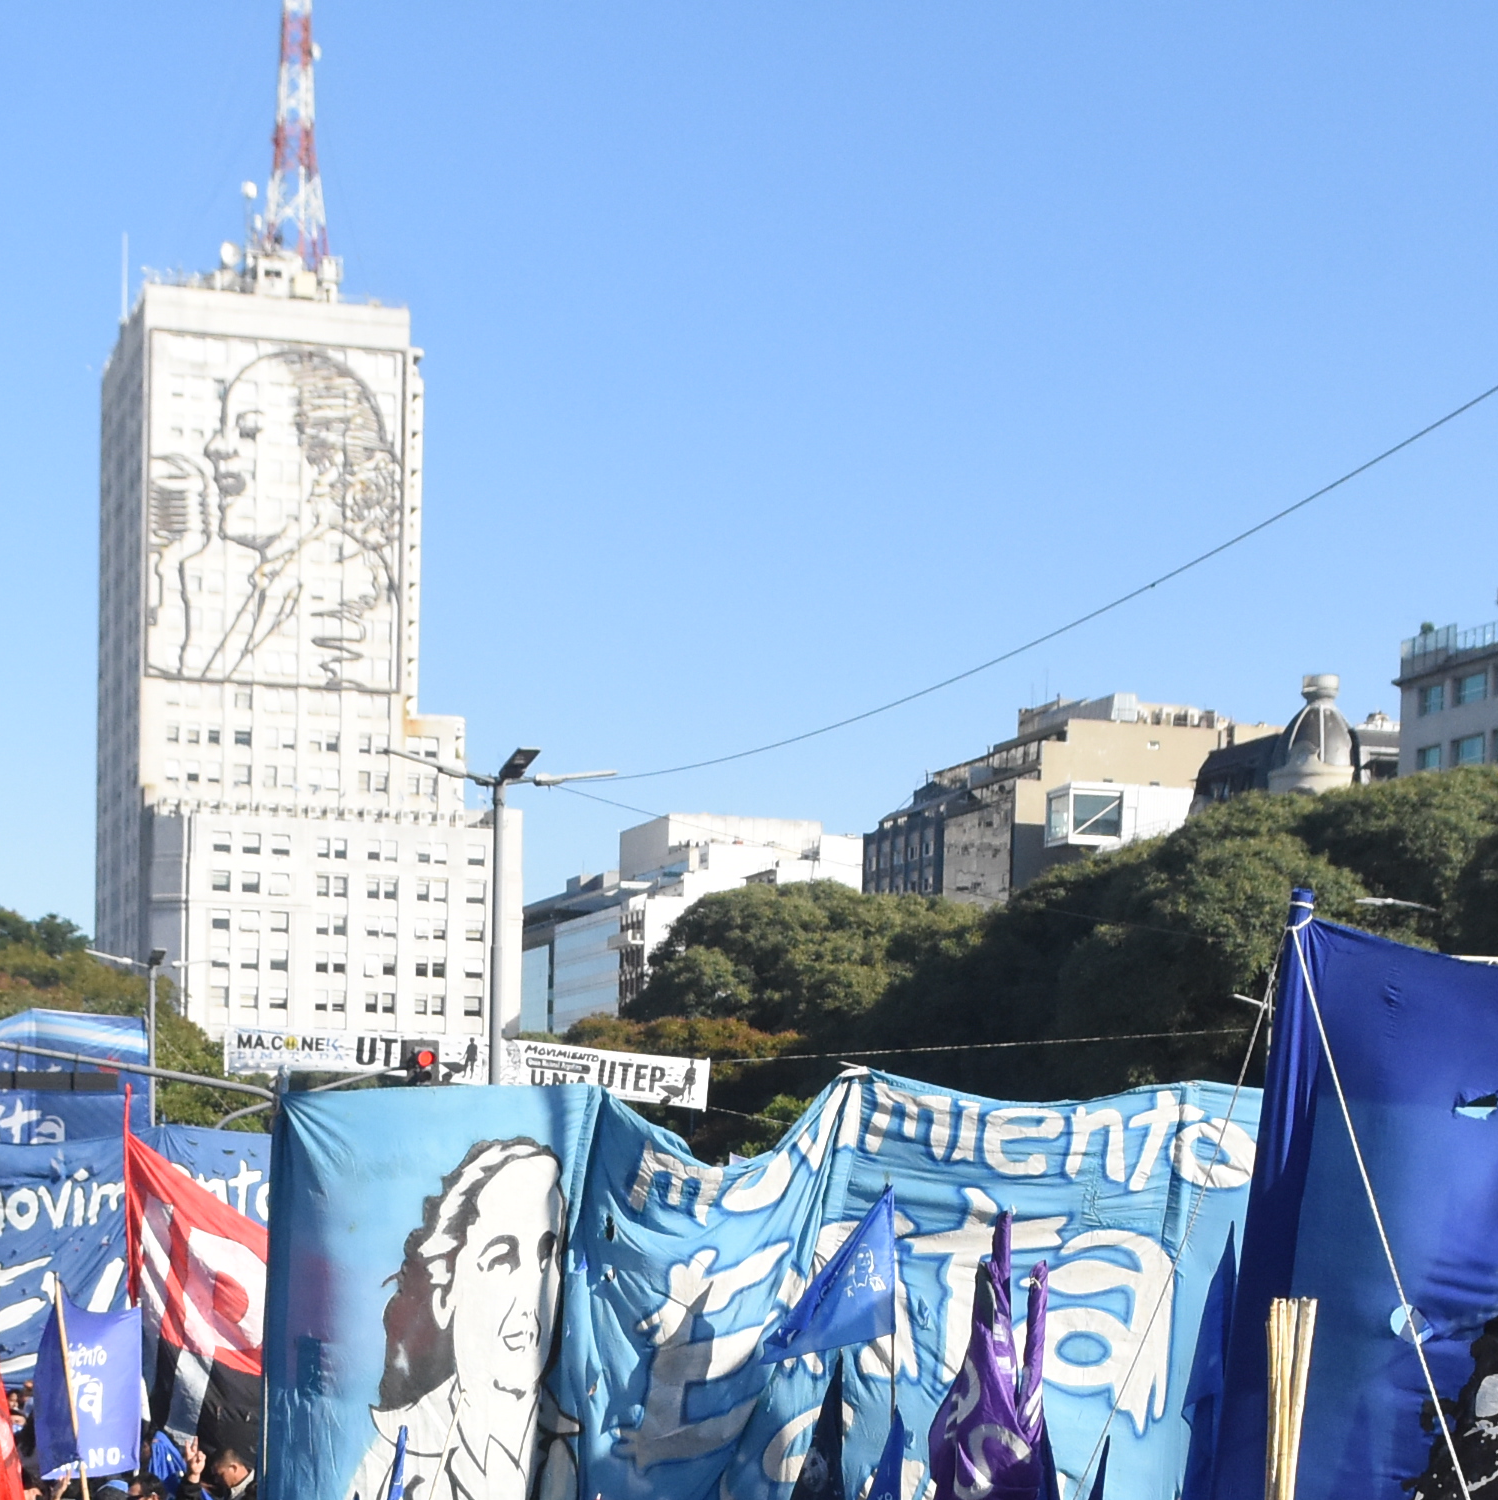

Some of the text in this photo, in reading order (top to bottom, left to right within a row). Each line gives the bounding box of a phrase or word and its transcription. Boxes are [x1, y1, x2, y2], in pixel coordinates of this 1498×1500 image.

[356, 1036, 403, 1068] UT
[524, 1044, 599, 1063] MOVIMIENTO
[598, 1058, 665, 1094] UTEP
